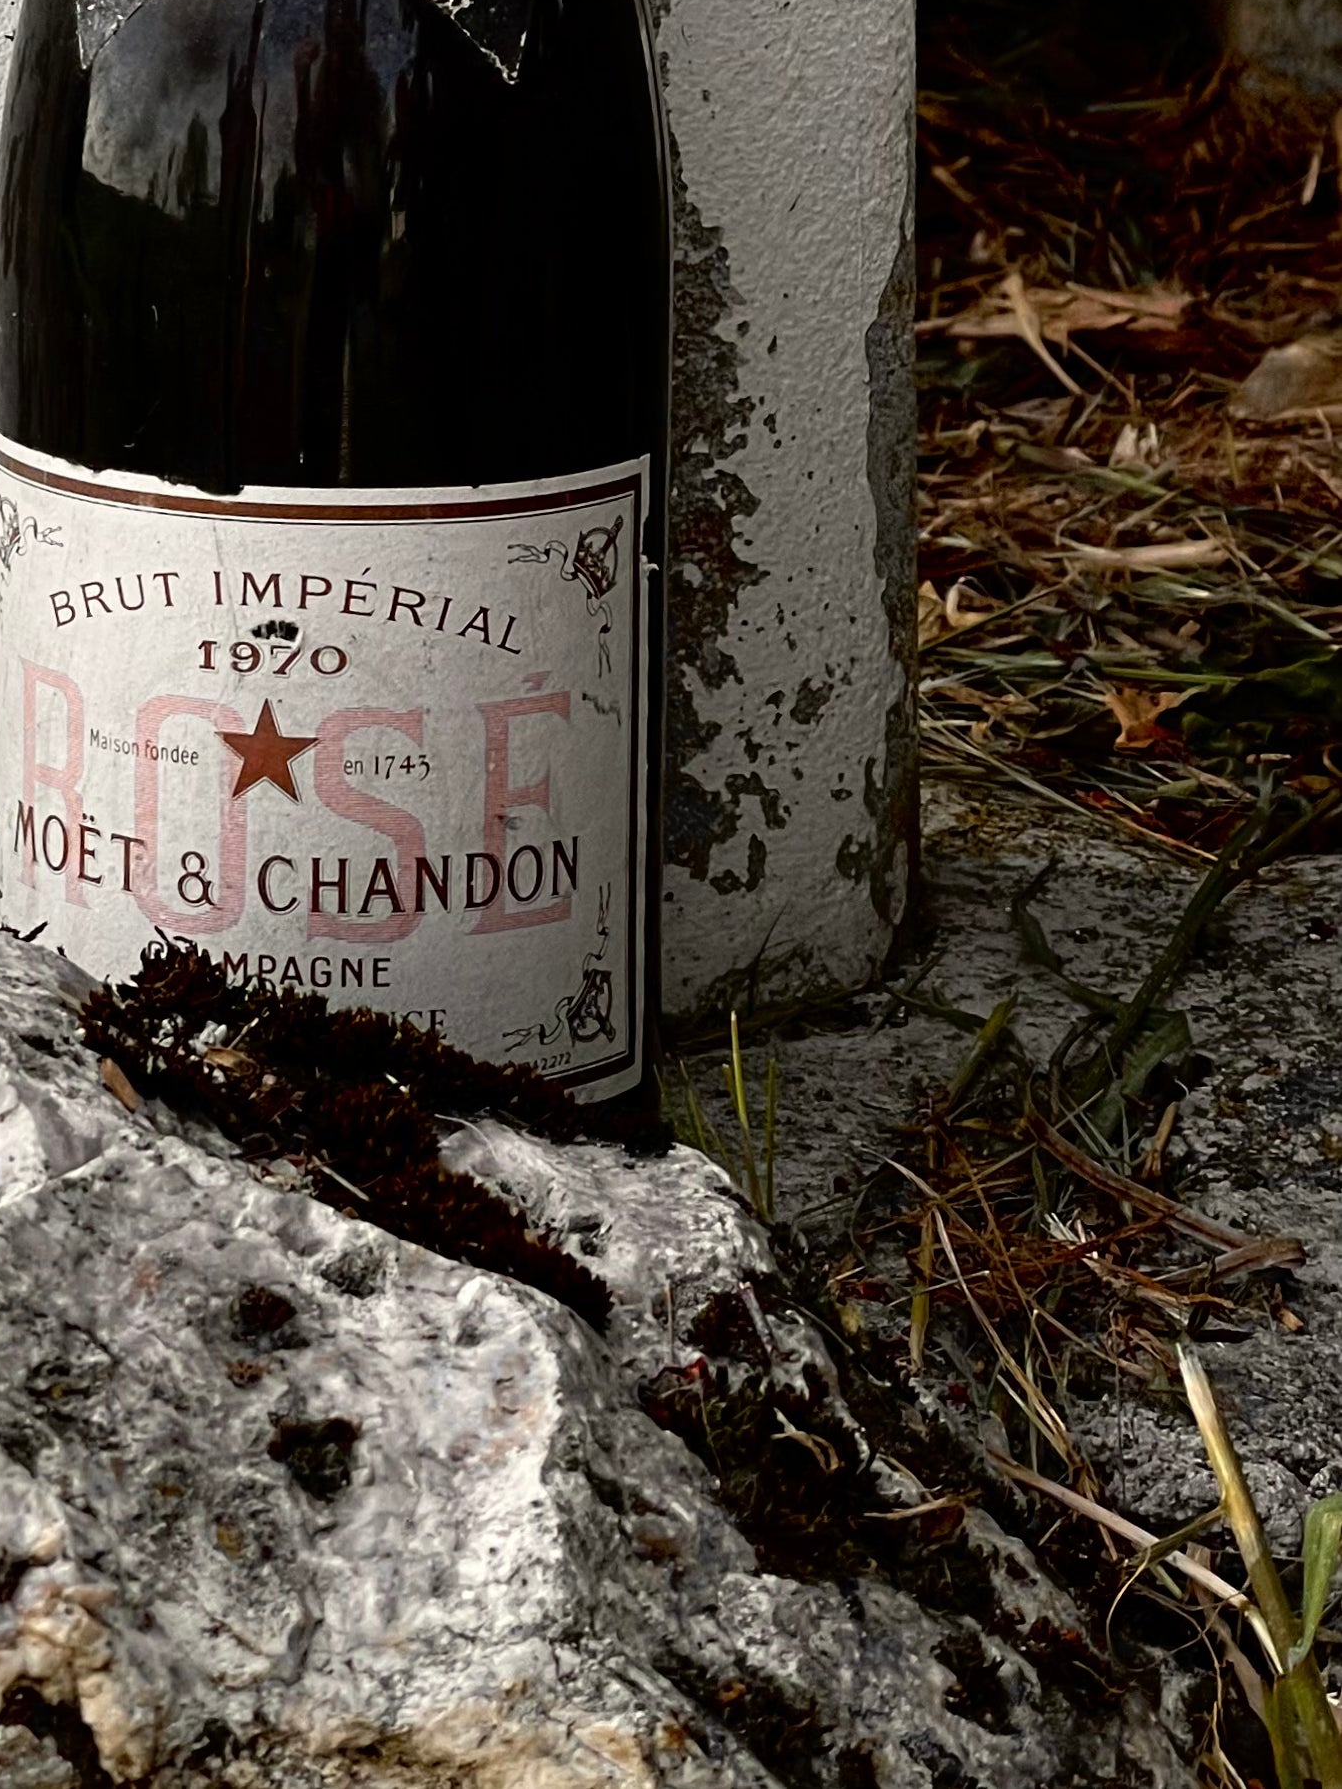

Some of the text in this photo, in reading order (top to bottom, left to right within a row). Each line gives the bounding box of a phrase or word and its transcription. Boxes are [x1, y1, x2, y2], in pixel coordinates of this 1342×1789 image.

[49, 566, 522, 656] BRUT IMPÉRIAL
[197, 639, 349, 677] 1970
[89, 727, 431, 781] Maison fondée en 1743
[18, 655, 571, 945] ROSÉ
[12, 799, 580, 915] MOËT & CHANDON
[223, 950, 392, 988] MPAGNE
